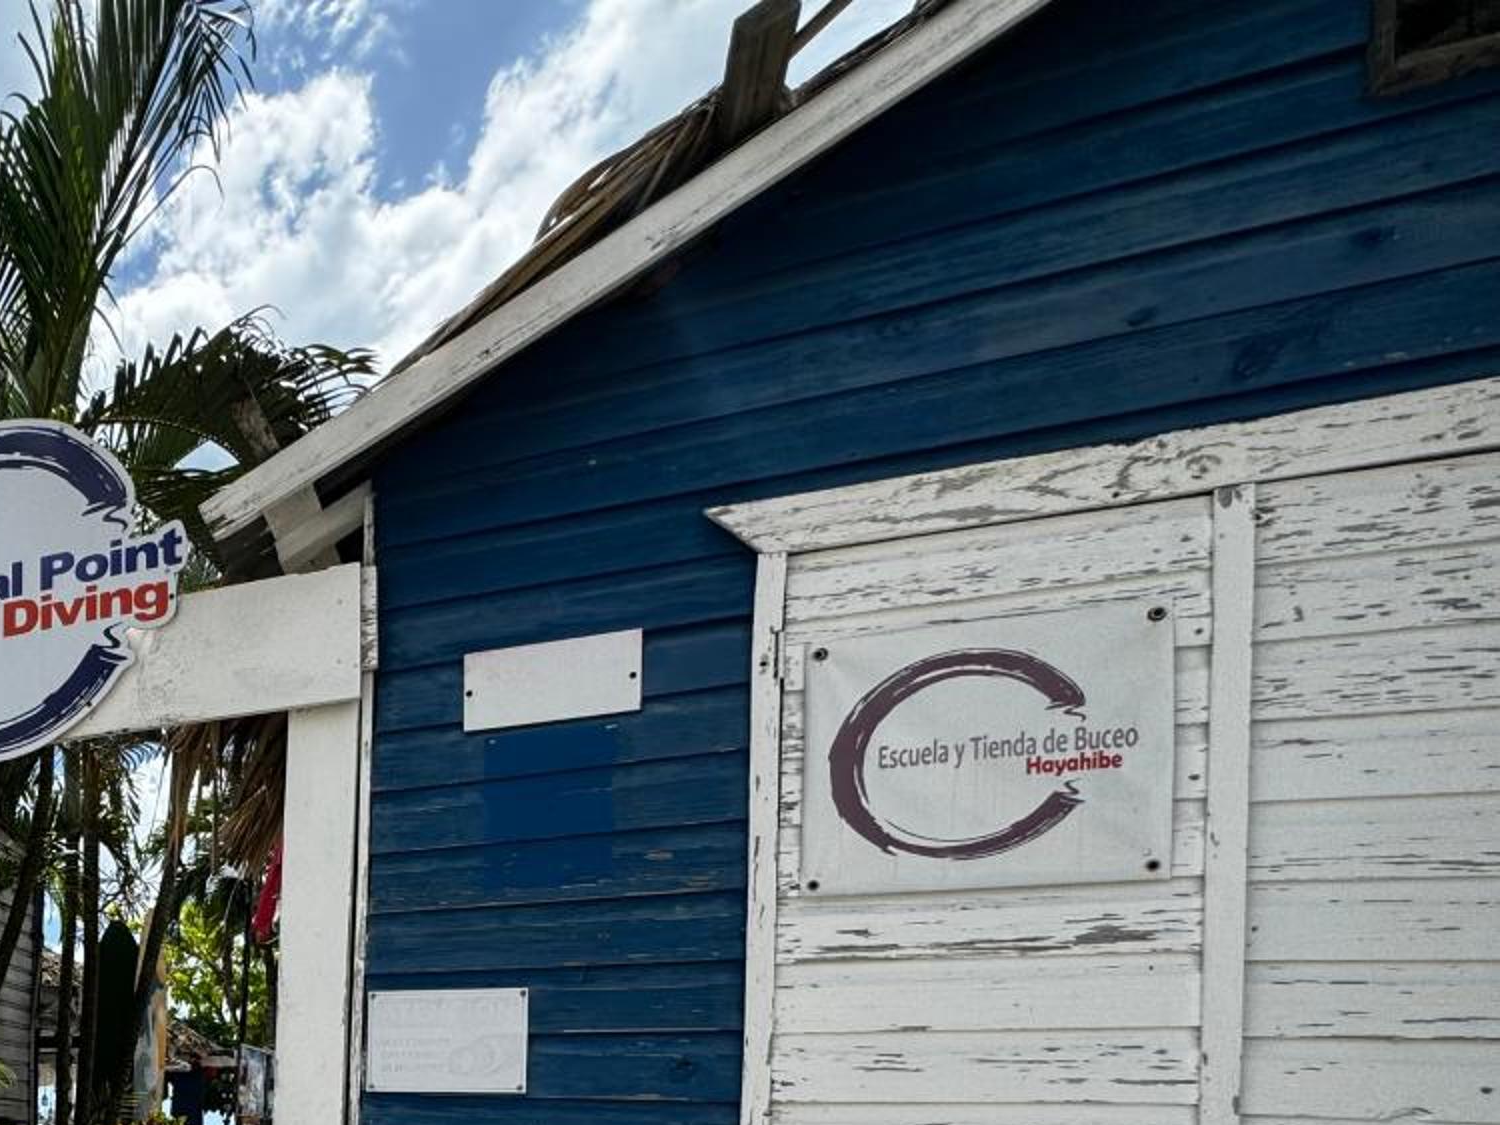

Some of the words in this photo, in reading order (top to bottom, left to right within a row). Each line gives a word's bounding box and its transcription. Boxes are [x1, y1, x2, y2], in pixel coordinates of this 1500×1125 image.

[40, 528, 183, 591] Point
[3, 579, 170, 638] Diving
[878, 737, 949, 769] Escuela
[954, 743, 965, 769] y
[970, 731, 1037, 761] Tienda
[1043, 728, 1069, 755] de
[1075, 726, 1140, 751] Buceo
[1026, 750, 1123, 776] Hayahibe
